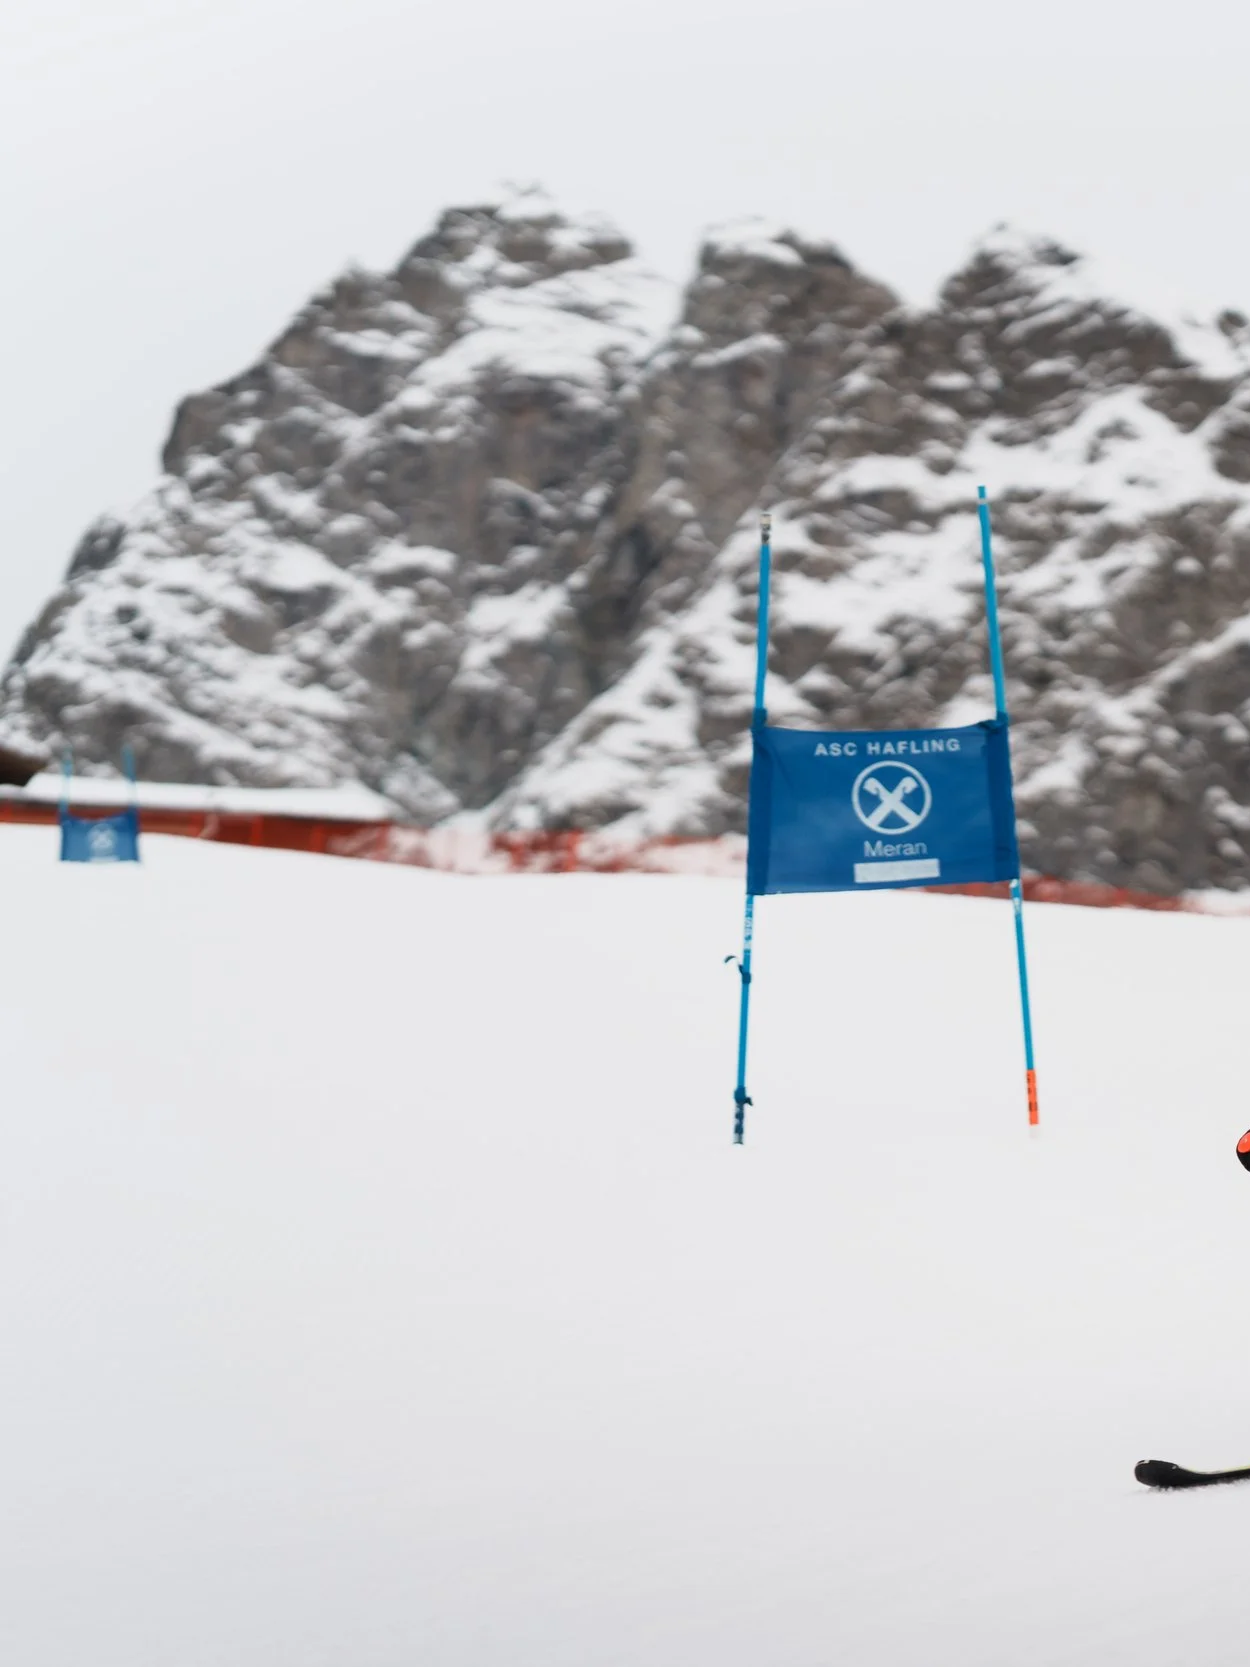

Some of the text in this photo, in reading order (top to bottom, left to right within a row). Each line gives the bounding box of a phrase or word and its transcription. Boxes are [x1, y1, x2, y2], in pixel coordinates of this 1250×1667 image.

[814, 738, 961, 756] ASC HAFLING
[863, 839, 929, 857] Meran
